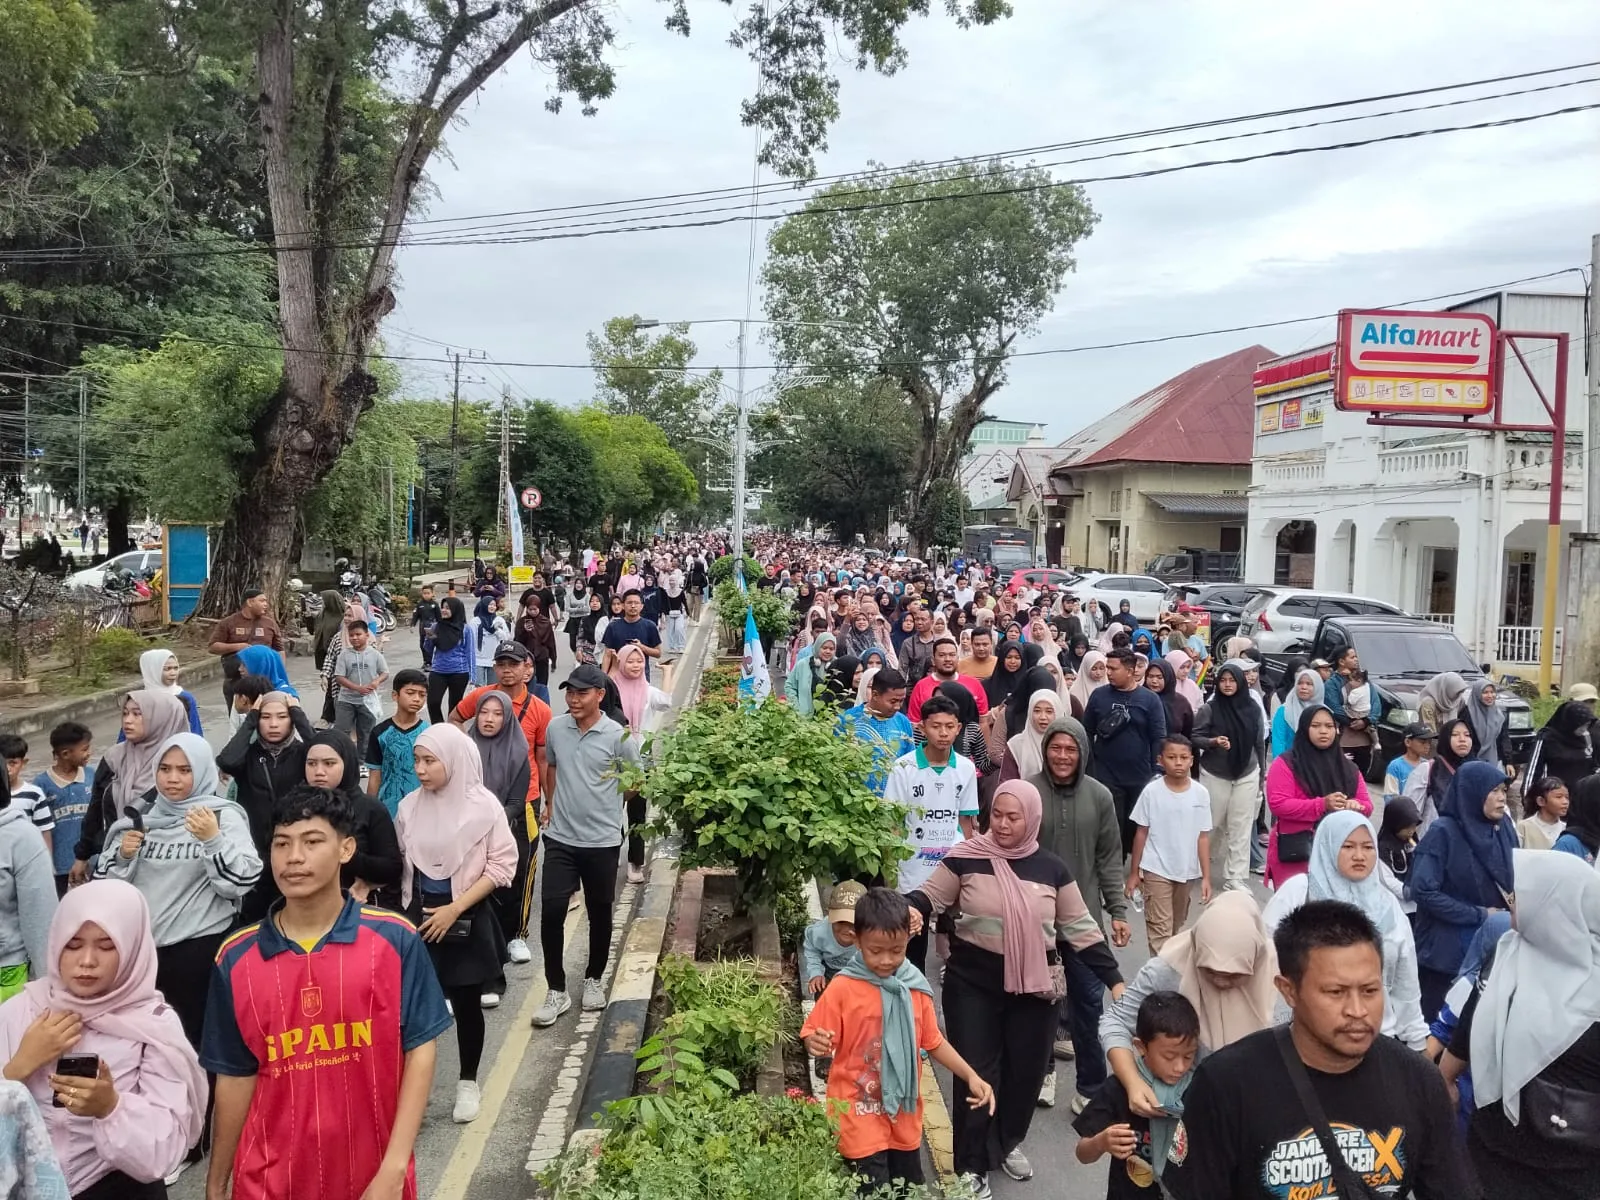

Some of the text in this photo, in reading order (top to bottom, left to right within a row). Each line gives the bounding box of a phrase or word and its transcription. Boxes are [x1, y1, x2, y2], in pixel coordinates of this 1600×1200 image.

[1360, 322, 1482, 348] Alfamart
[912, 785, 924, 798] 30
[138, 840, 202, 860] THLETIC
[1268, 1154, 1332, 1186] SCOOTE
[1367, 1126, 1404, 1181] X
[1287, 1181, 1324, 1200] KOTA
